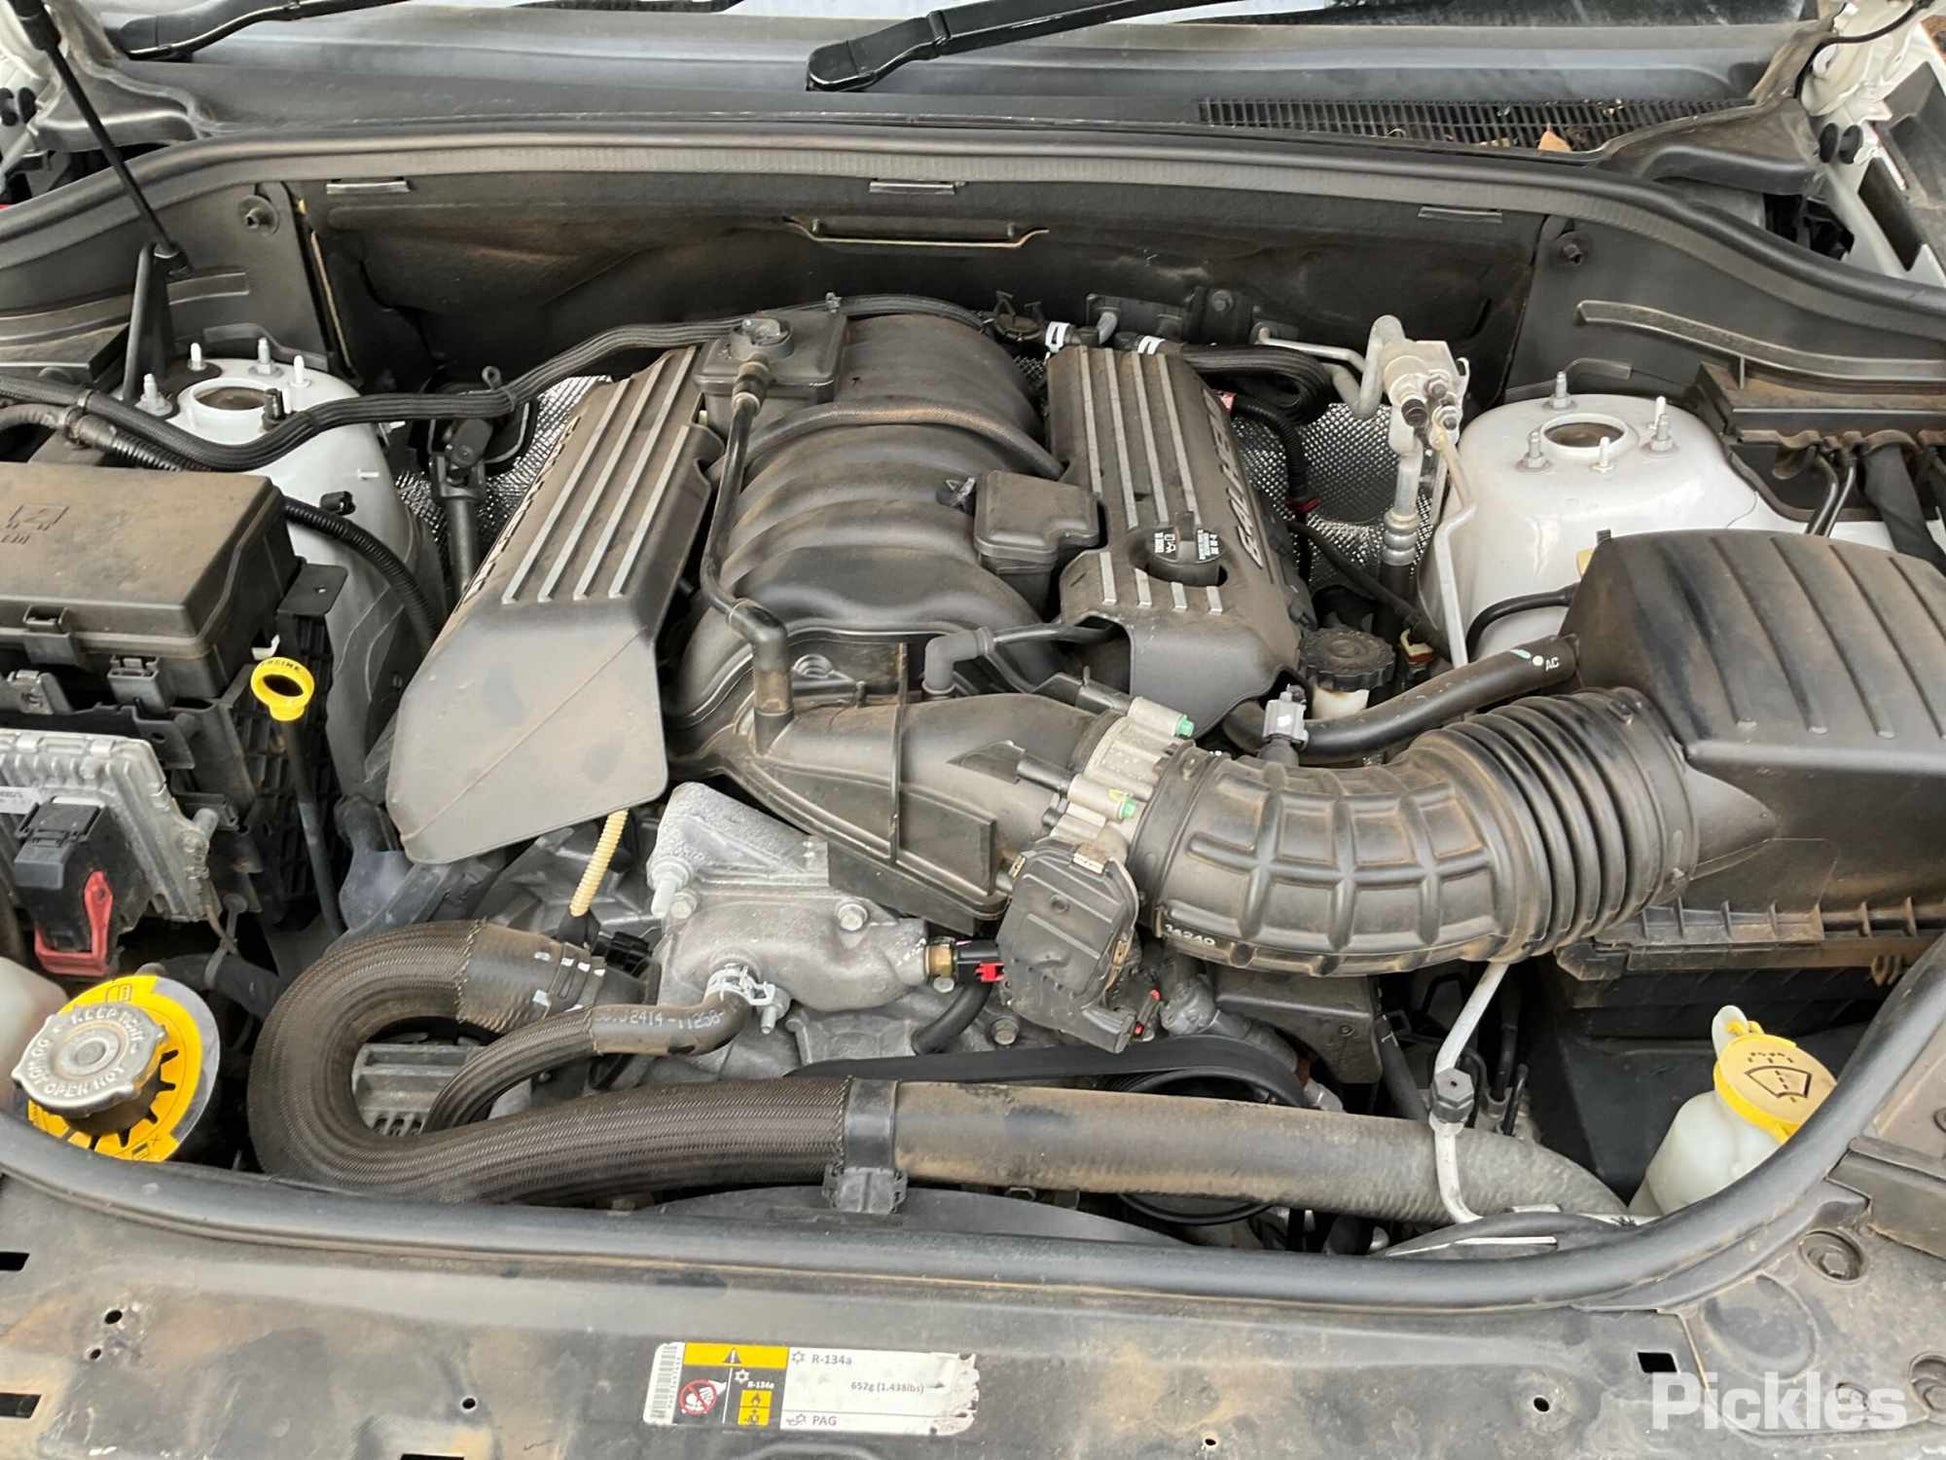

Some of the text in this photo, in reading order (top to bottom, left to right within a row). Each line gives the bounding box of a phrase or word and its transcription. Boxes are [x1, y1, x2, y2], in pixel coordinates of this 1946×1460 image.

[1545, 656, 1560, 672] AC
[43, 1081, 89, 1097] OPEN
[811, 1354, 852, 1365] R-134a
[811, 1415, 838, 1426] PAG
